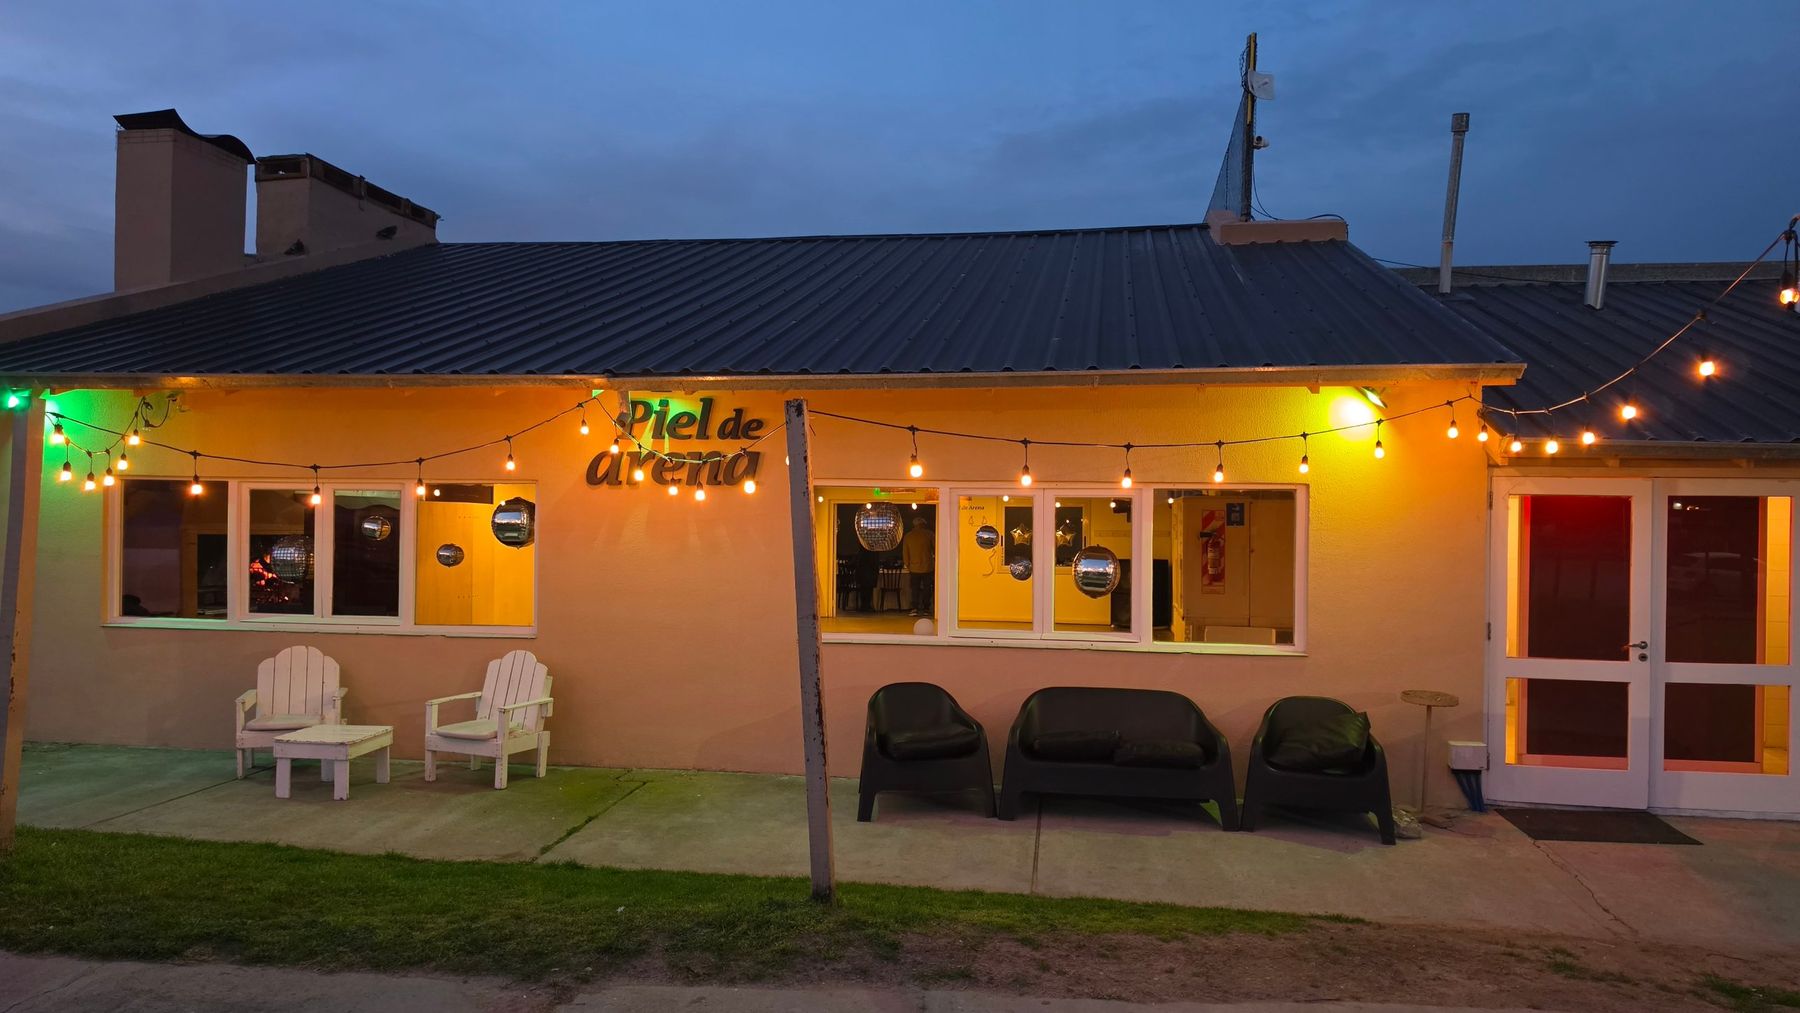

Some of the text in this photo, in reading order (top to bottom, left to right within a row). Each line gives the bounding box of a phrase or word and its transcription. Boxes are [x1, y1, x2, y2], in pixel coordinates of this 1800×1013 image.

[616, 398, 764, 440] Piel de
[585, 450, 761, 487] arena
